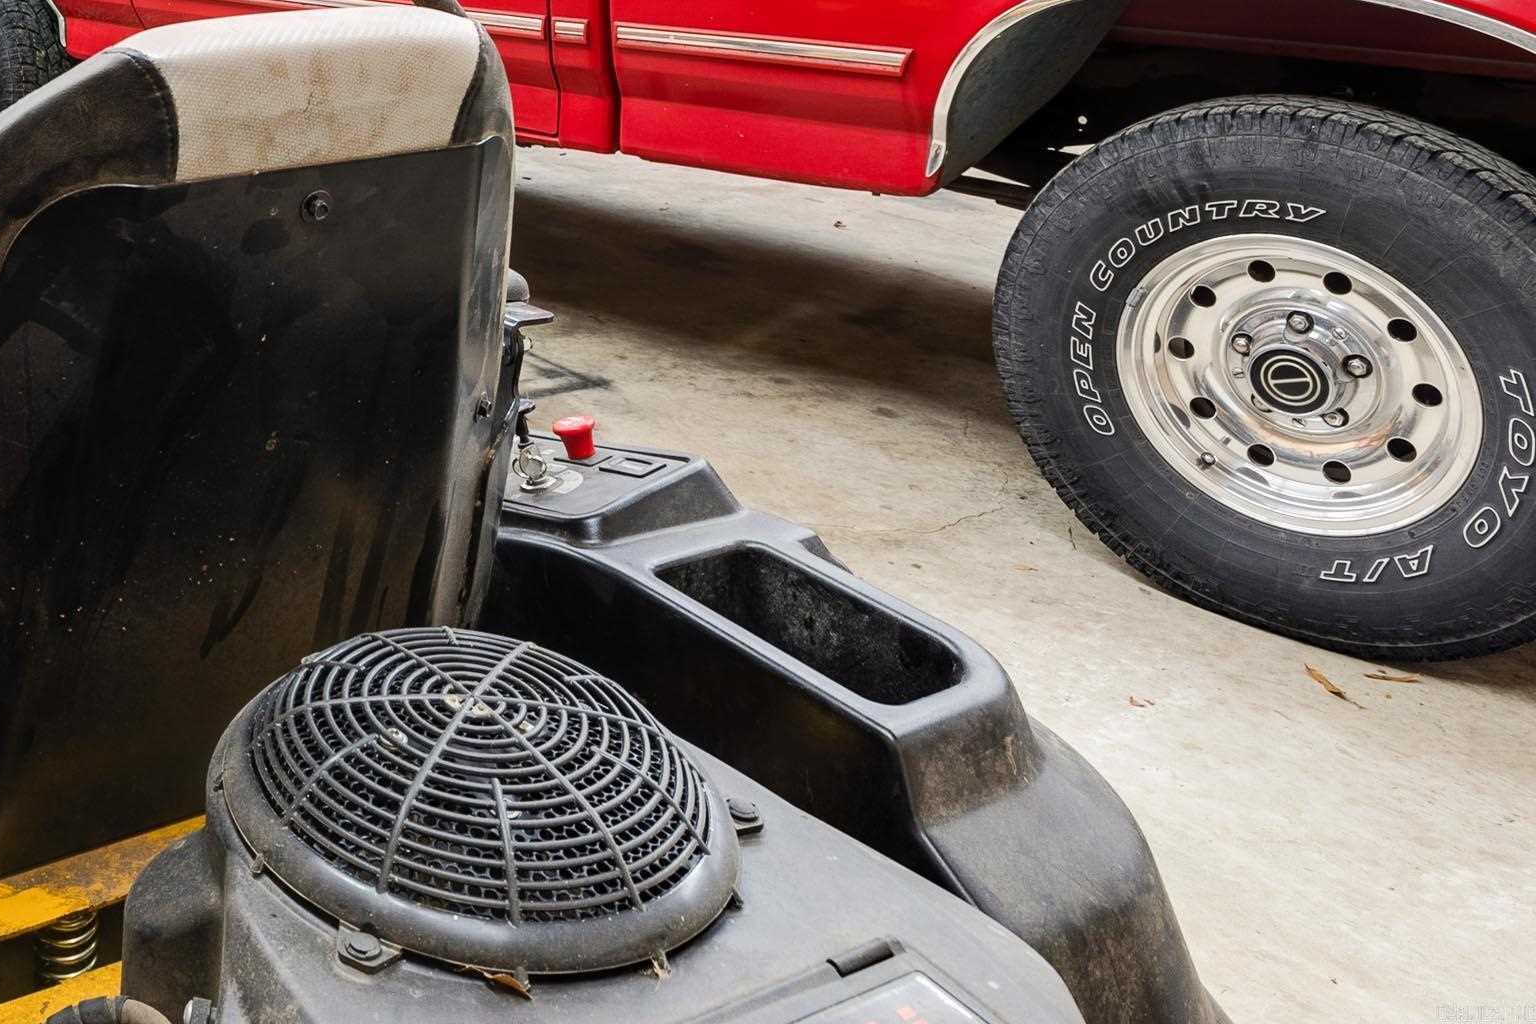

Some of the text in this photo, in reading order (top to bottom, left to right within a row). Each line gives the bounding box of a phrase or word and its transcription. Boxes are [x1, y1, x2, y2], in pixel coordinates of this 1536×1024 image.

[1068, 198, 1328, 437] OPEN COUNTRY
[1319, 368, 1536, 583] TOYO A/T
